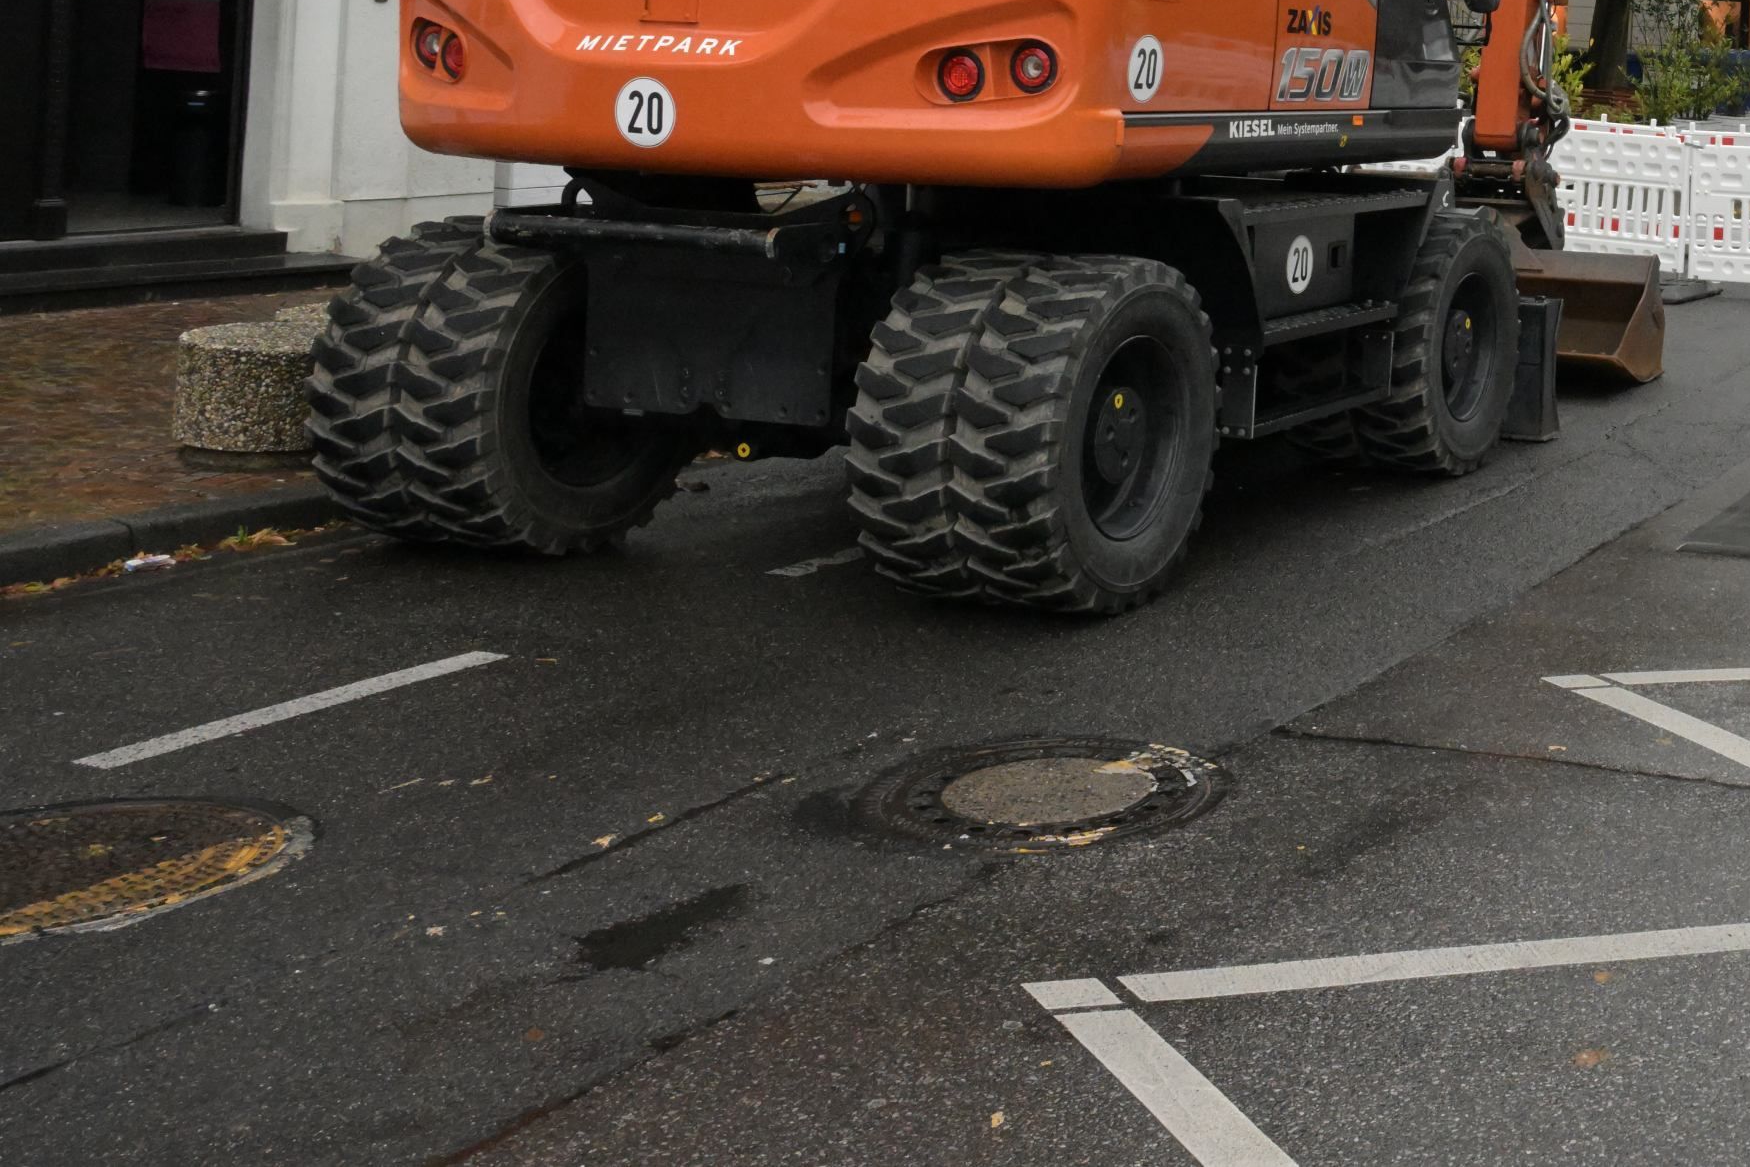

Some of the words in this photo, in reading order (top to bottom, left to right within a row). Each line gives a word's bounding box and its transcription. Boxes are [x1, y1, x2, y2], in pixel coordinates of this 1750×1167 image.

[1287, 5, 1331, 35] ZAXIS
[576, 35, 743, 56] MIETPARK
[1134, 48, 1157, 89] 20
[1276, 47, 1370, 101] 150W
[628, 90, 663, 135] 20
[1229, 119, 1275, 138] KIESEL
[1277, 123, 1293, 135] Mein
[1294, 122, 1339, 136] Systempartner.
[1292, 247, 1308, 283] 20
